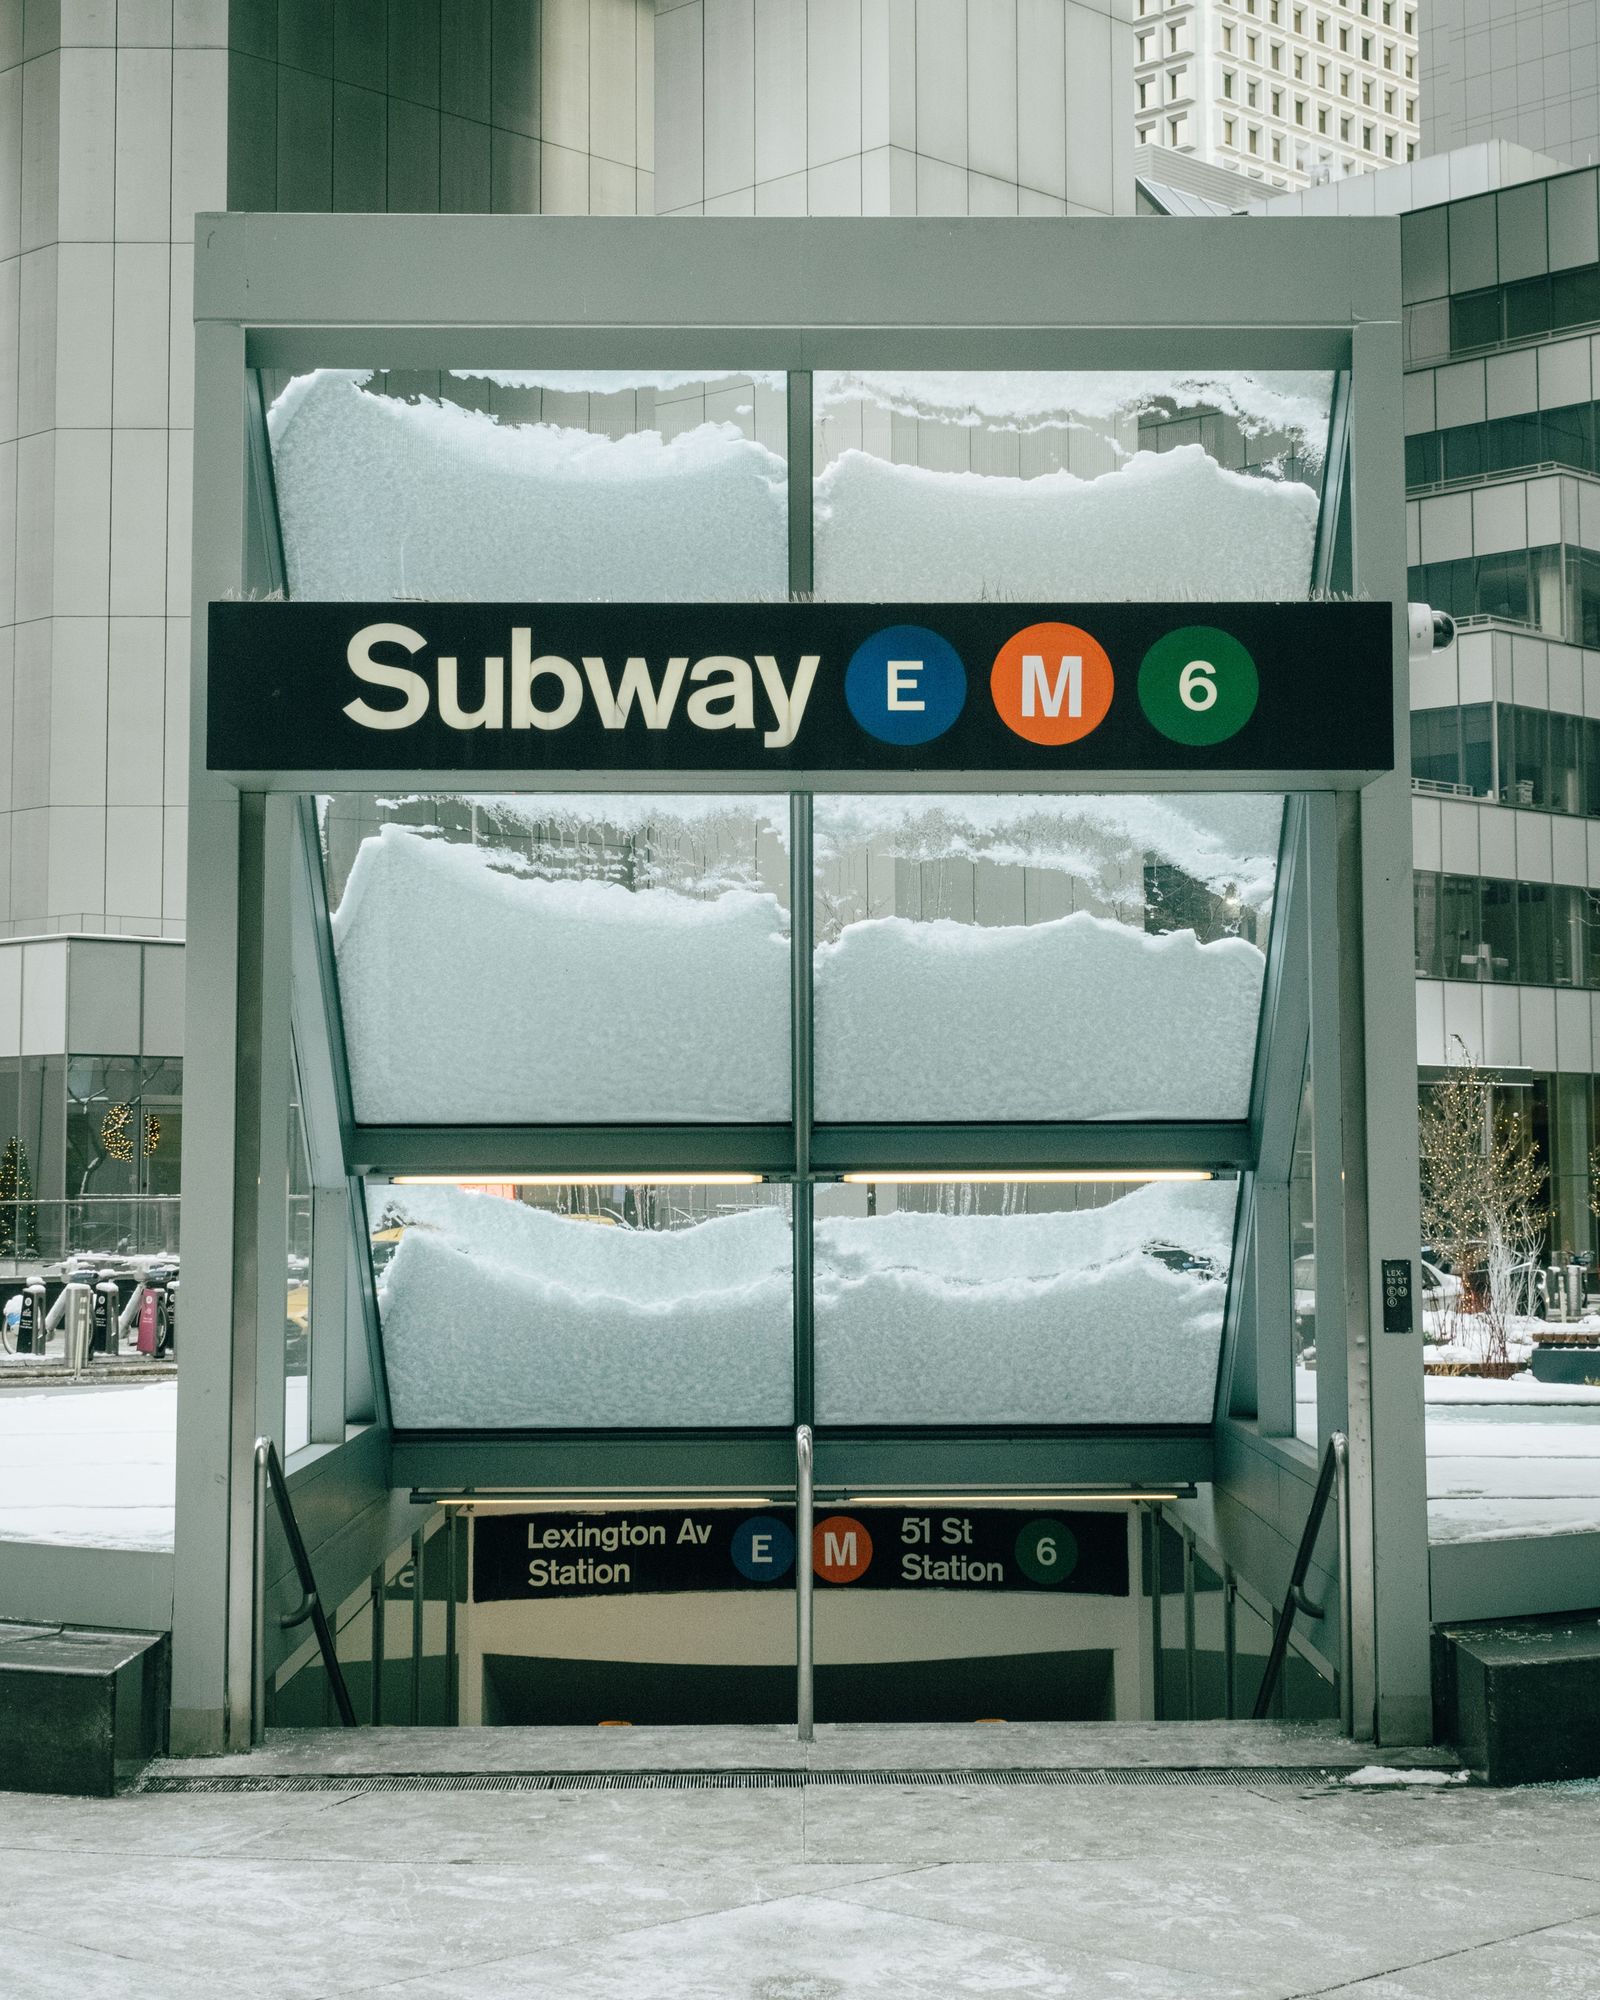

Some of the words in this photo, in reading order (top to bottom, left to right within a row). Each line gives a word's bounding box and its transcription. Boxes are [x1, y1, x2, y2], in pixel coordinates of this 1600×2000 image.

[342, 622, 821, 748] Subway
[886, 660, 926, 711] E
[1021, 655, 1083, 718] M
[1178, 660, 1218, 712] 6
[1397, 1277, 1408, 1285] ST
[527, 1520, 666, 1552] Lexington
[676, 1517, 713, 1545] Av
[900, 1517, 931, 1545] 51
[941, 1517, 973, 1545] St
[751, 1534, 773, 1563] E
[824, 1531, 858, 1567] M
[1036, 1537, 1057, 1566] 6
[527, 1557, 631, 1587] Station
[901, 1553, 1004, 1582] Station
